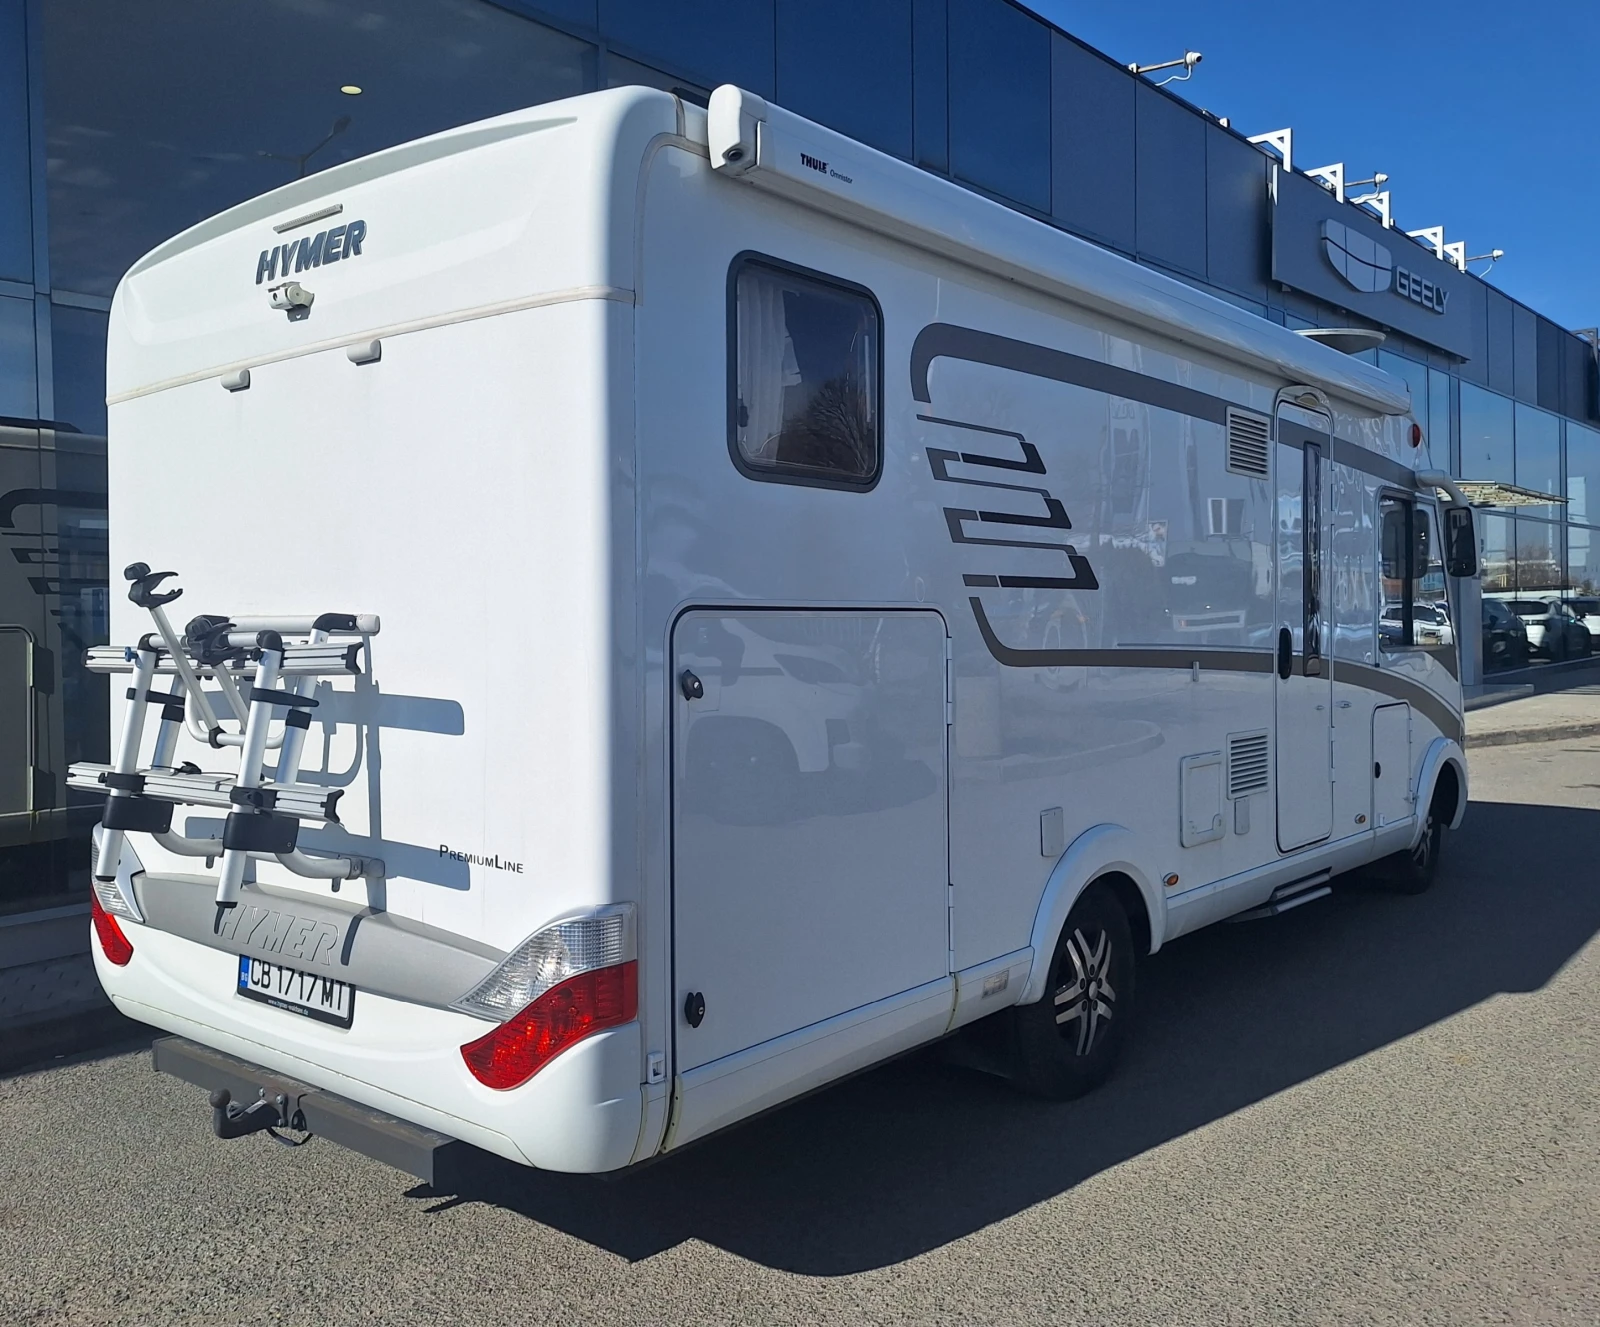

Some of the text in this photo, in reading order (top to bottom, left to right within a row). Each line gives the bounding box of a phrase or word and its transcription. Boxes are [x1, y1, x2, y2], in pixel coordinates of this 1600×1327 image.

[800, 152, 827, 174] THULE
[256, 220, 367, 285] HYMER
[1396, 266, 1449, 314] GEELY
[217, 903, 340, 966] HYMER
[251, 958, 347, 1011] CB 1717 MT
